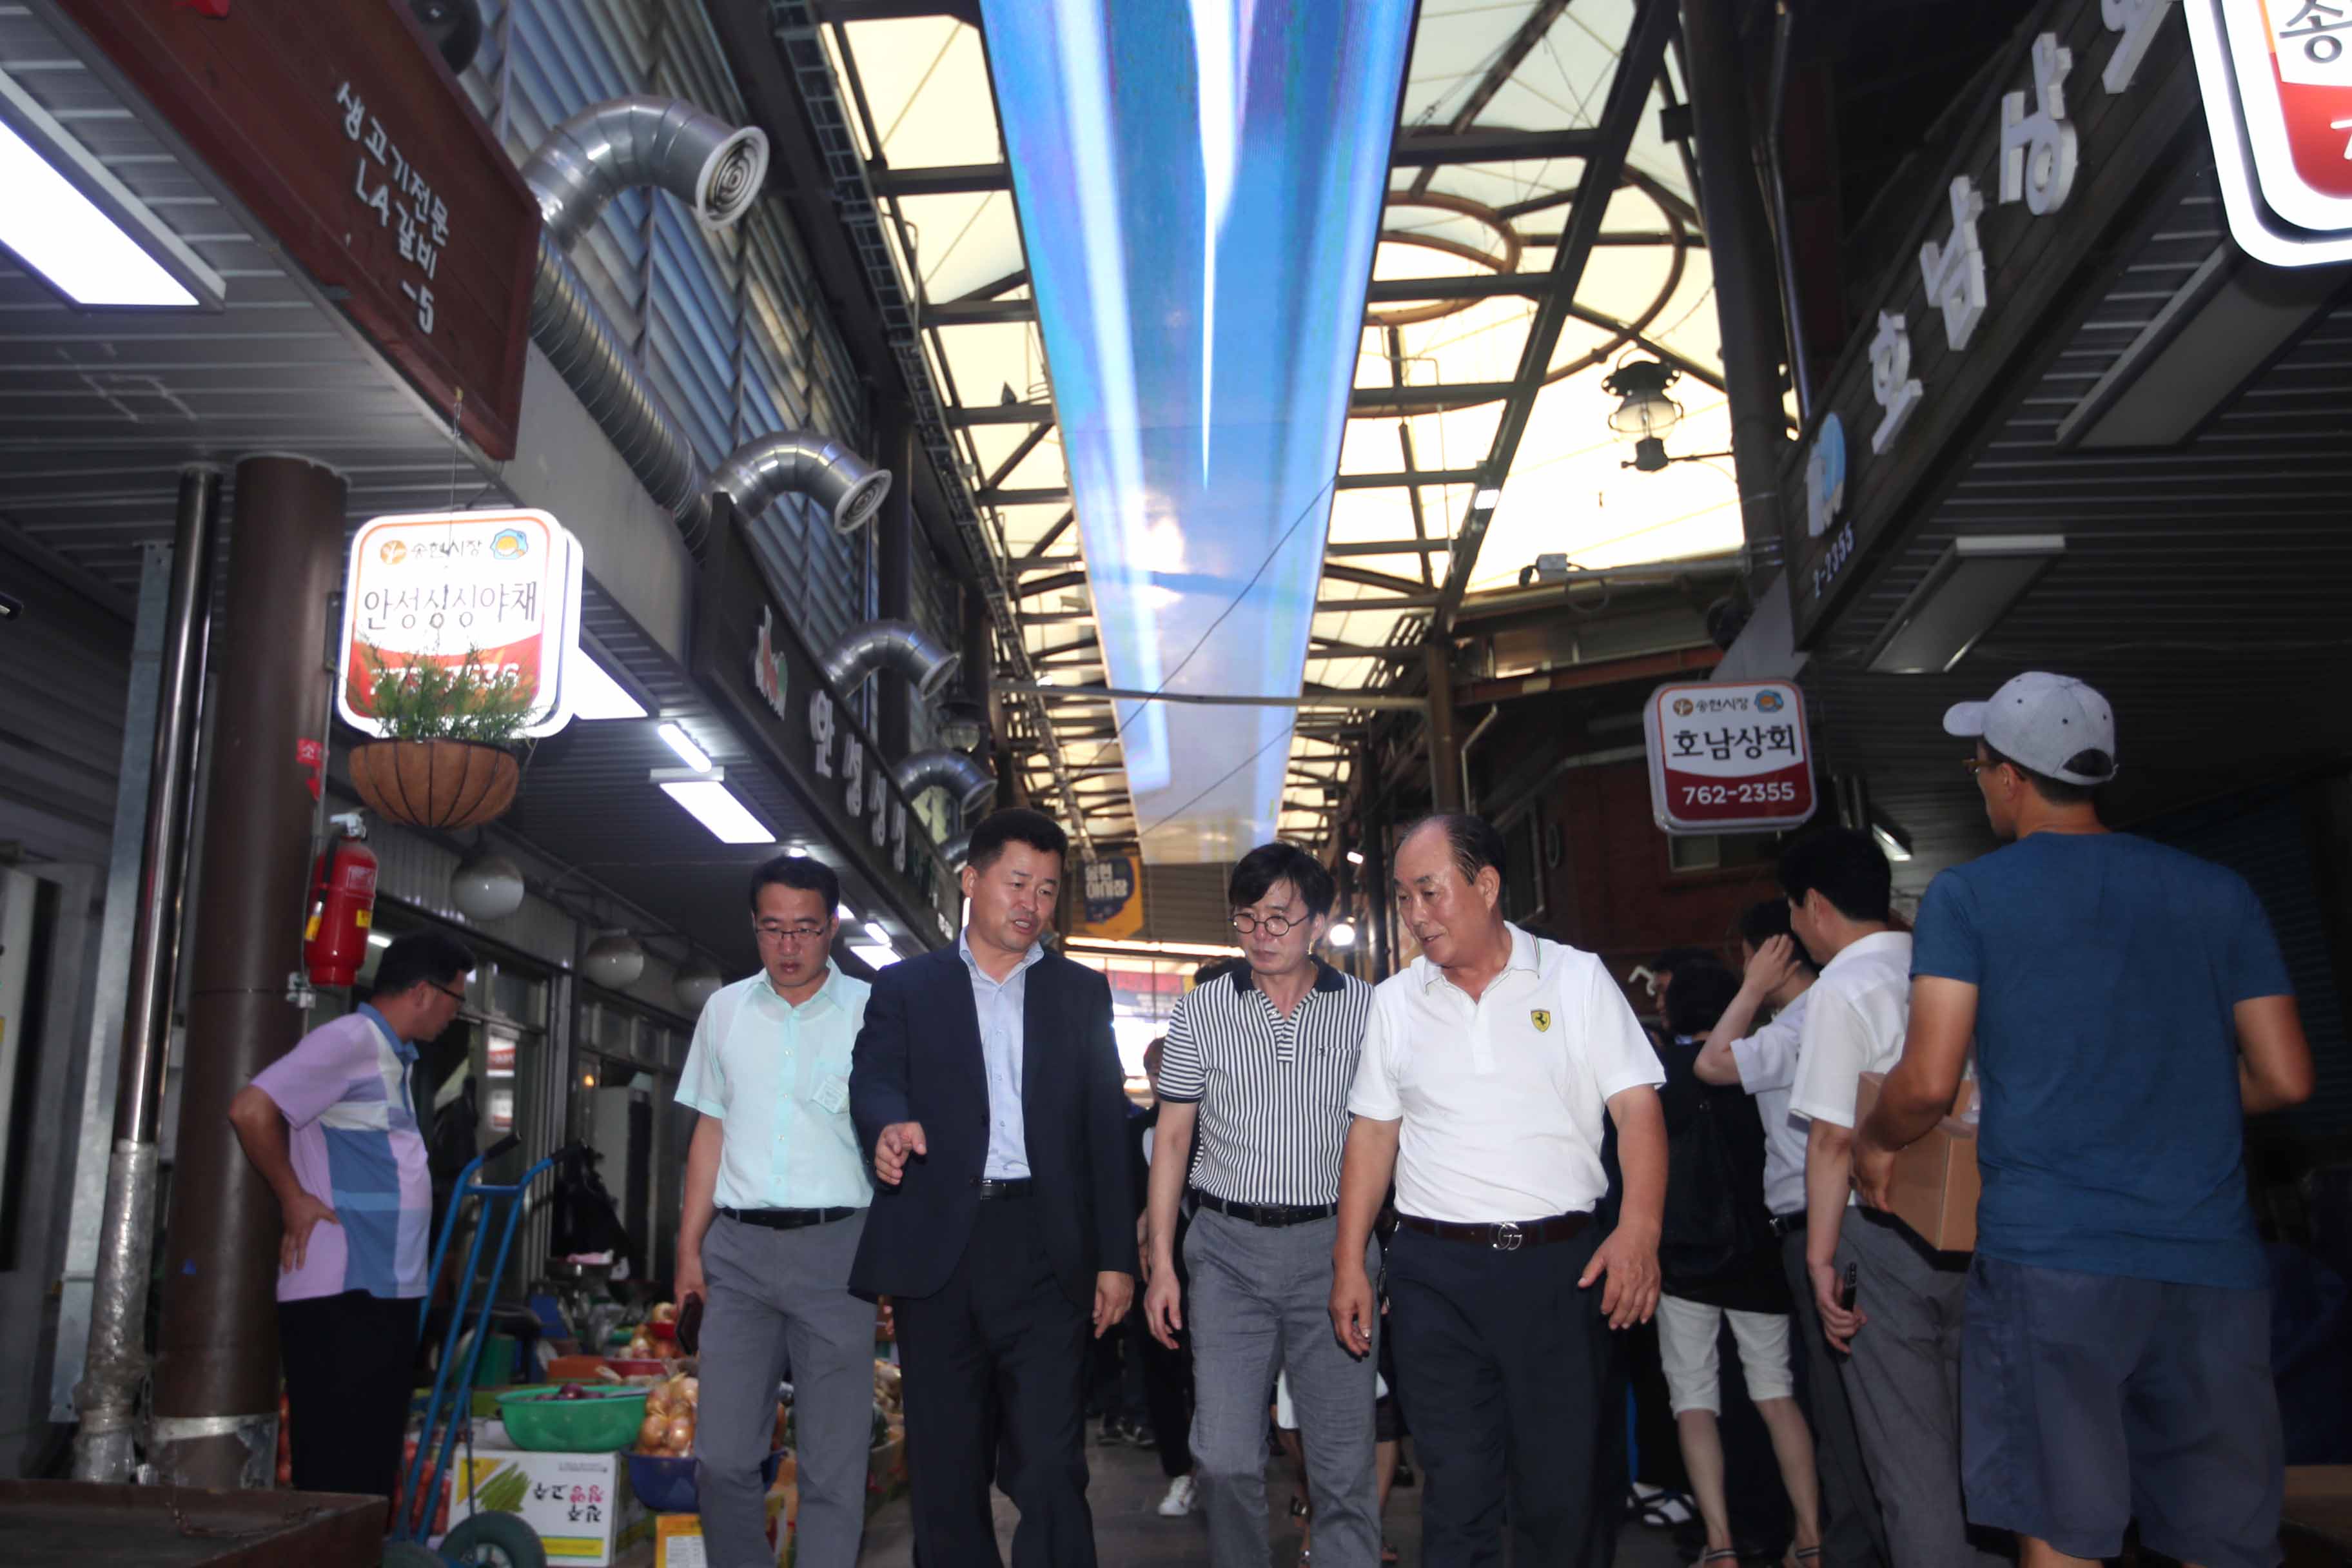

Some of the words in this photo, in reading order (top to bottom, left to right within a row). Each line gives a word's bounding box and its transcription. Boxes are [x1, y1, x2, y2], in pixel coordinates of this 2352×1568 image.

[337, 82, 449, 246] 생고기전문
[356, 159, 389, 227] LA
[395, 201, 437, 280] 갈비
[364, 581, 538, 630] 안성싱싱야채
[1696, 698, 1749, 712] 송현시장
[1672, 724, 1796, 761] 호남상회
[1681, 781, 1796, 805] 762-2355
